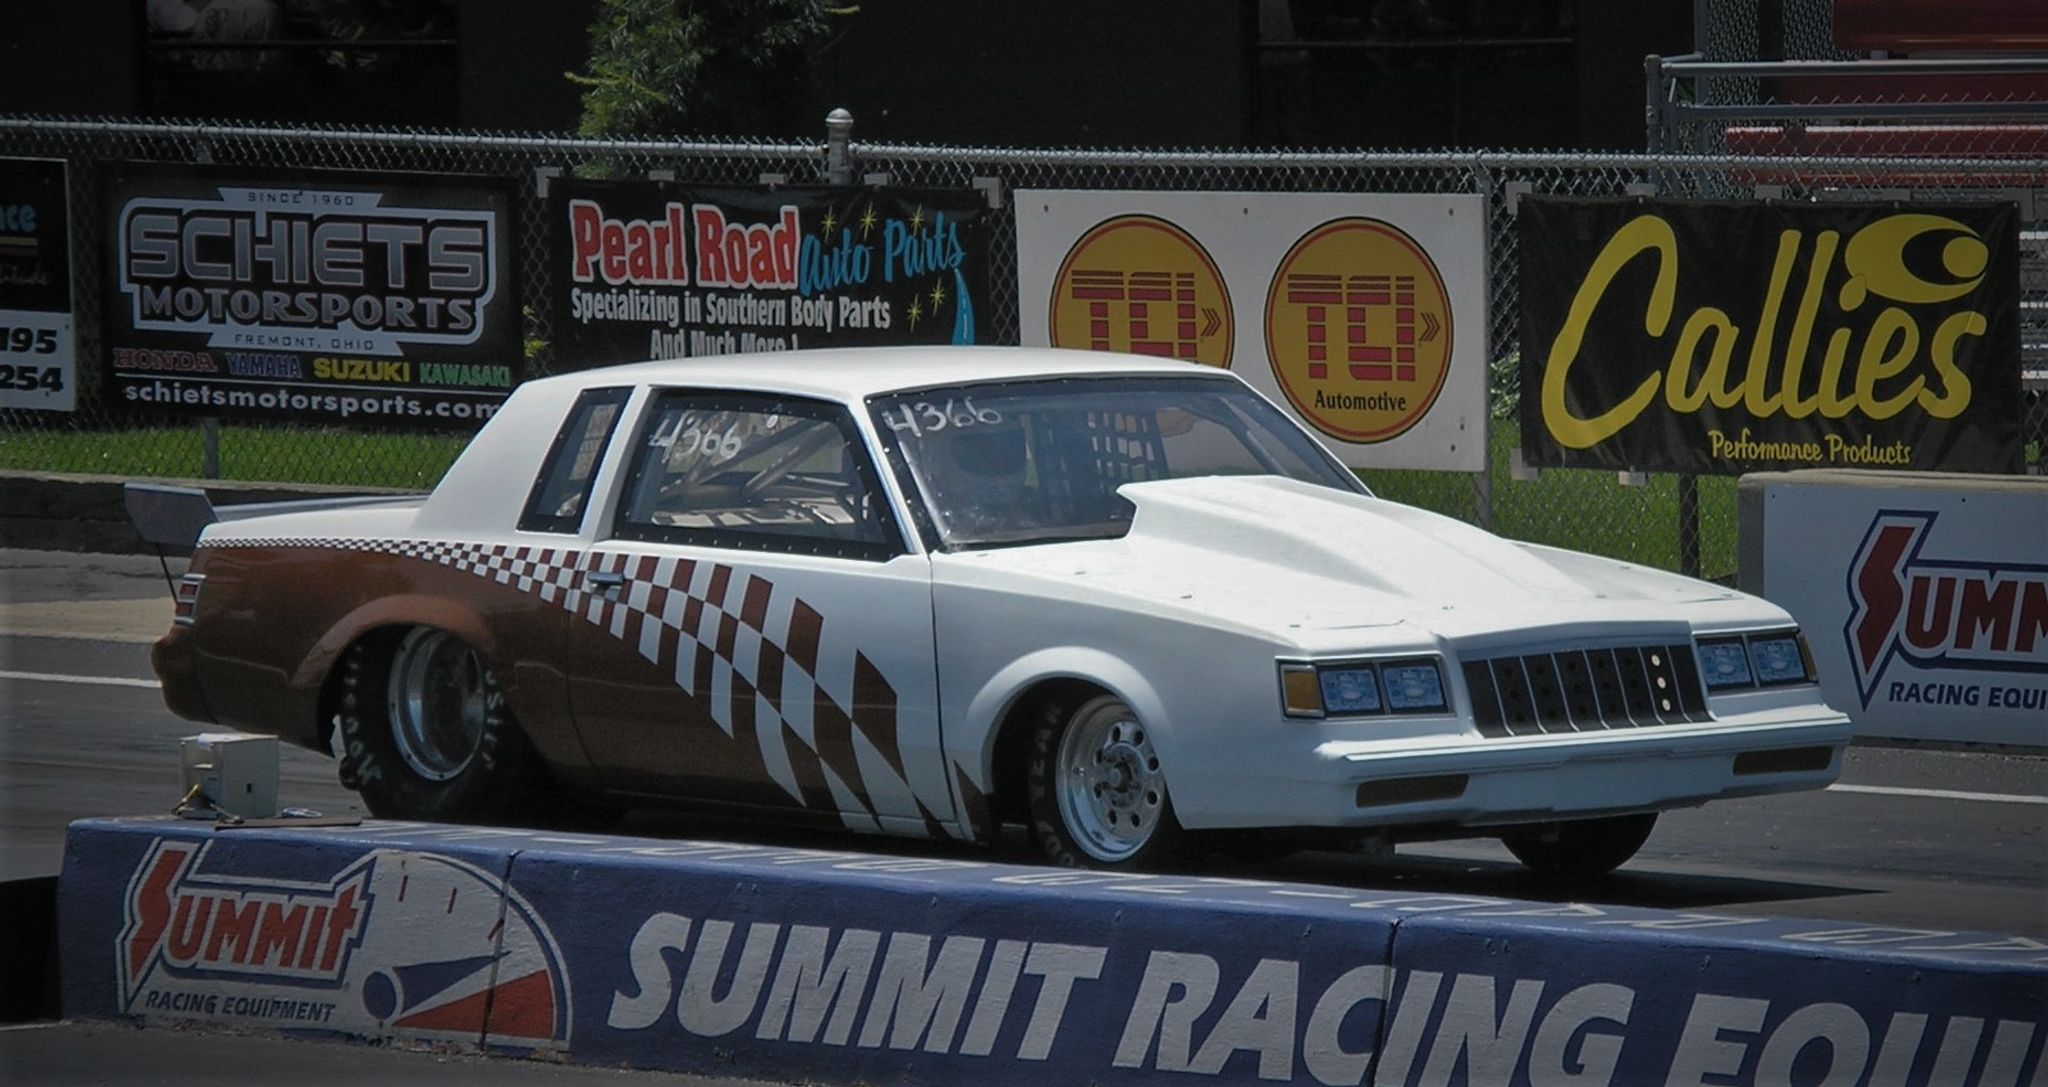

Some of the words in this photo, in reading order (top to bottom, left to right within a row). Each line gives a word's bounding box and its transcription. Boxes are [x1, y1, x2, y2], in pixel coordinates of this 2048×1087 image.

[0, 204, 38, 232] ce
[248, 192, 300, 205] SINCE
[313, 194, 354, 207] 1960
[130, 213, 485, 292] SCHIETS
[569, 198, 688, 287] Pearl
[692, 203, 799, 290] Road
[799, 226, 874, 298] Auto
[883, 210, 967, 283] Parts
[141, 283, 474, 331] MOTORSPORTS
[570, 287, 680, 328] Specializing
[684, 289, 702, 324] in
[705, 290, 786, 327] Southern
[790, 294, 835, 333] Body
[838, 295, 891, 330] Parts
[1072, 270, 1197, 359] TCI
[332, 338, 374, 351] OHIO
[650, 329, 686, 360] And
[690, 330, 736, 357] Much
[1288, 274, 1416, 382] TCI
[1541, 212, 1990, 450] Callies
[113, 347, 218, 373] HONDA
[226, 351, 302, 379] YAMAHA
[313, 357, 411, 383] SUZUKI
[419, 362, 511, 388] KAWASAKI
[125, 380, 501, 418] schietsmotorsports.com
[883, 396, 1002, 438] 4366
[1314, 389, 1408, 413] Automotive
[648, 410, 742, 464] 4366
[1707, 427, 1822, 464] Performance
[1824, 432, 1912, 465] Products
[1889, 682, 1980, 707] RACING
[146, 990, 218, 1016] RACING
[222, 996, 337, 1023] EQUIPMENT
[606, 911, 1110, 1061] SUMMIT
[1111, 949, 1637, 1087] RACING
[1664, 993, 2048, 1087] EQUI
